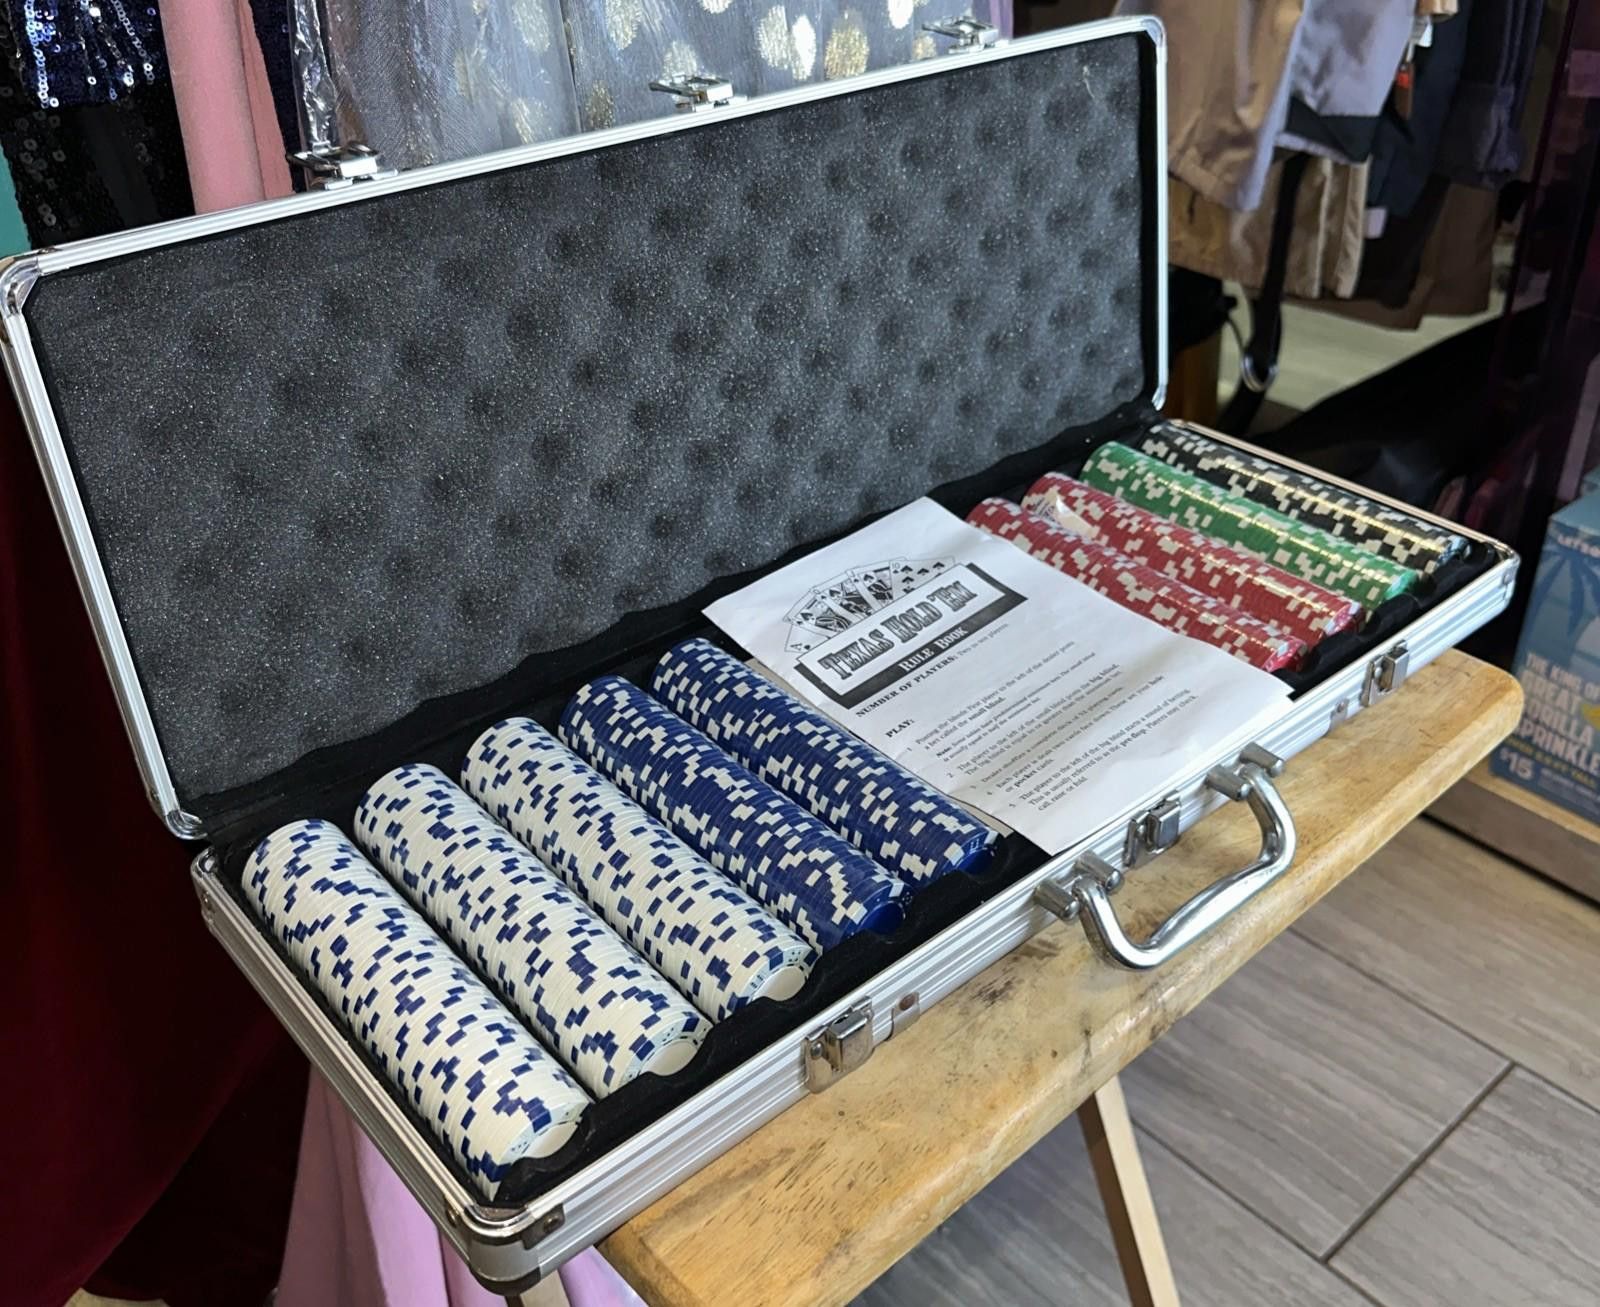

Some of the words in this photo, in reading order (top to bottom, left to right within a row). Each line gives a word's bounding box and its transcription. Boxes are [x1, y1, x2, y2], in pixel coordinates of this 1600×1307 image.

[818, 629, 891, 680] TEXAS
[880, 601, 943, 643] HOLD
[899, 648, 934, 673] RULE
[935, 627, 968, 649] BOOK
[1526, 652, 1549, 674] THE
[855, 690, 899, 716] NUMBER
[897, 681, 914, 691] OF
[913, 654, 958, 682] PLAYERS:
[1520, 669, 1581, 716] GREAT
[885, 717, 915, 737] PLAY:
[1525, 697, 1593, 749] ORILLA
